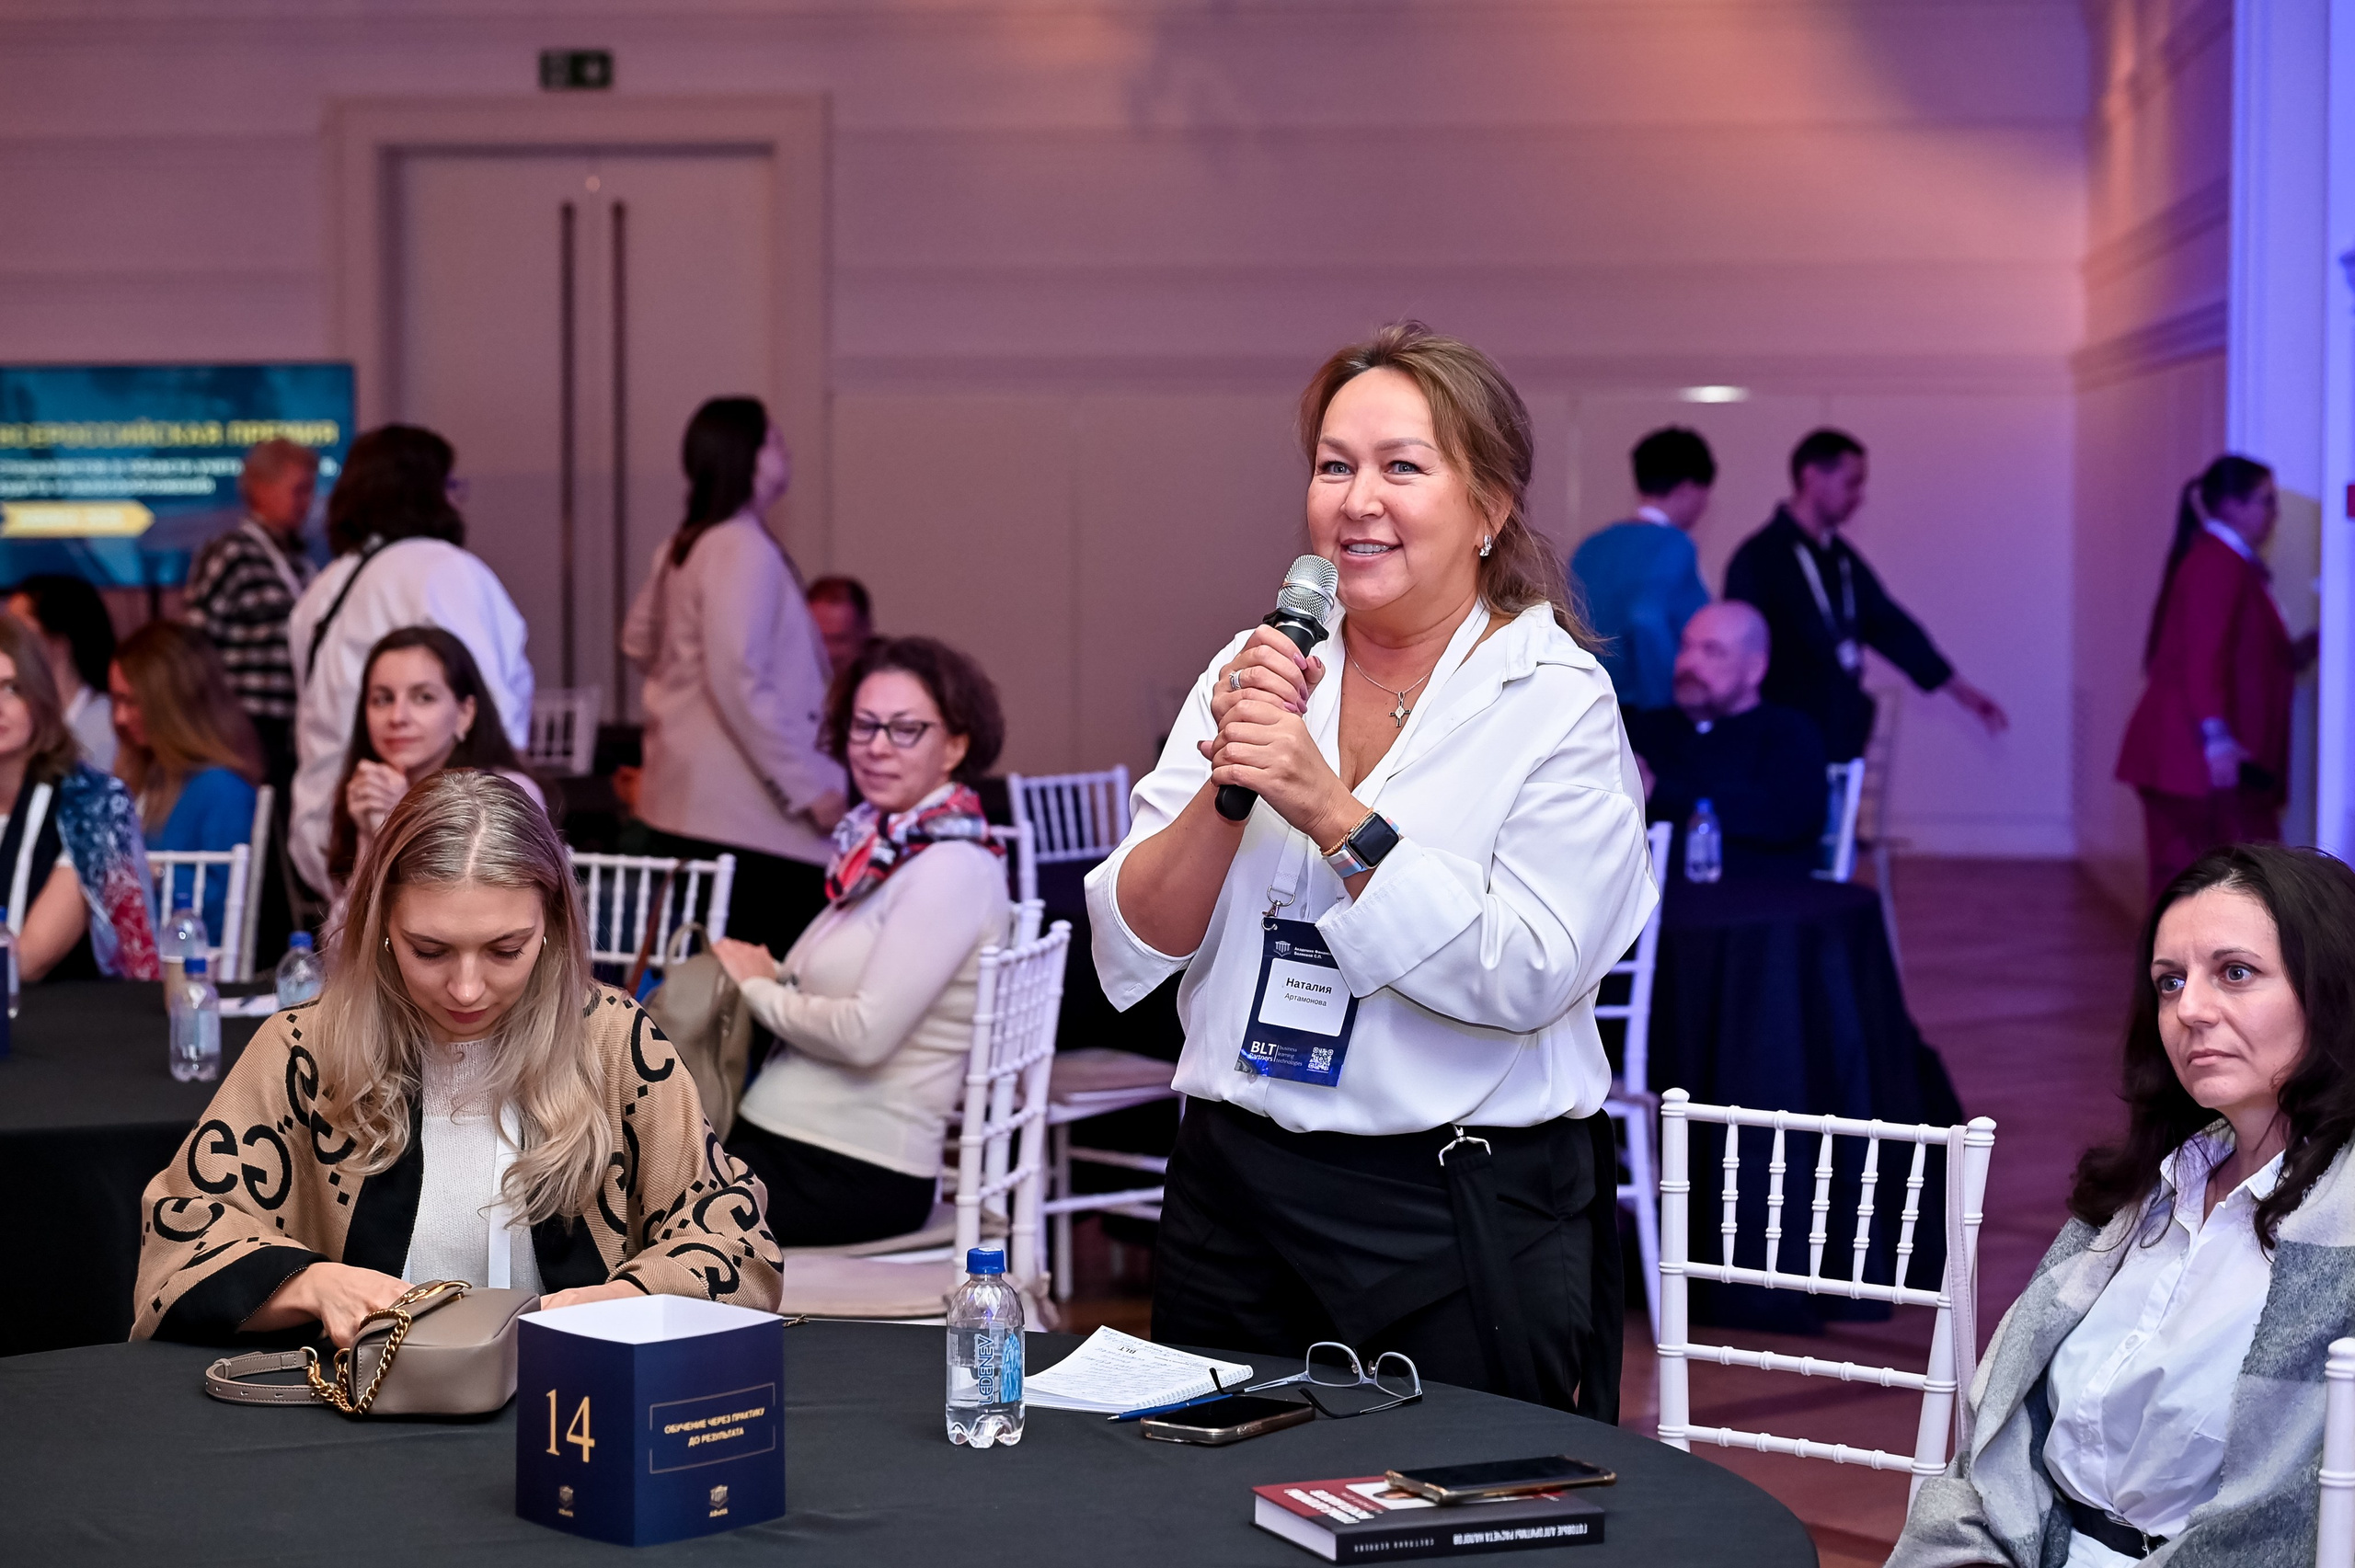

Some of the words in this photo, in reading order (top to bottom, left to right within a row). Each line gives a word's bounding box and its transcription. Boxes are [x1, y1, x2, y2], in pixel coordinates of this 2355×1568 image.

[1285, 977, 1332, 994] Наталия
[1284, 992, 1327, 1007] Артамонова
[1250, 1040, 1277, 1056] BLT
[1278, 1051, 1295, 1059] learning
[1249, 1052, 1273, 1062] Partners
[1276, 1058, 1303, 1067] technologies
[977, 1333, 994, 1404] LEDENEV
[546, 1388, 596, 1463] 14
[664, 1419, 706, 1434] ОБУЧЕНИЕ
[707, 1414, 730, 1426] ЧЕРЕЗ
[731, 1407, 764, 1422] ПРАКТИКУ
[688, 1435, 700, 1448] ДО
[701, 1426, 744, 1443] РЕЗУЛЬТАТА
[1485, 1529, 1513, 1542] РАСЧЕТА
[1514, 1526, 1556, 1539] АЛГОРИТМЫ
[1557, 1523, 1588, 1536] ГОТОВЫЕ
[1453, 1531, 1484, 1545] НАЛОГОВ
